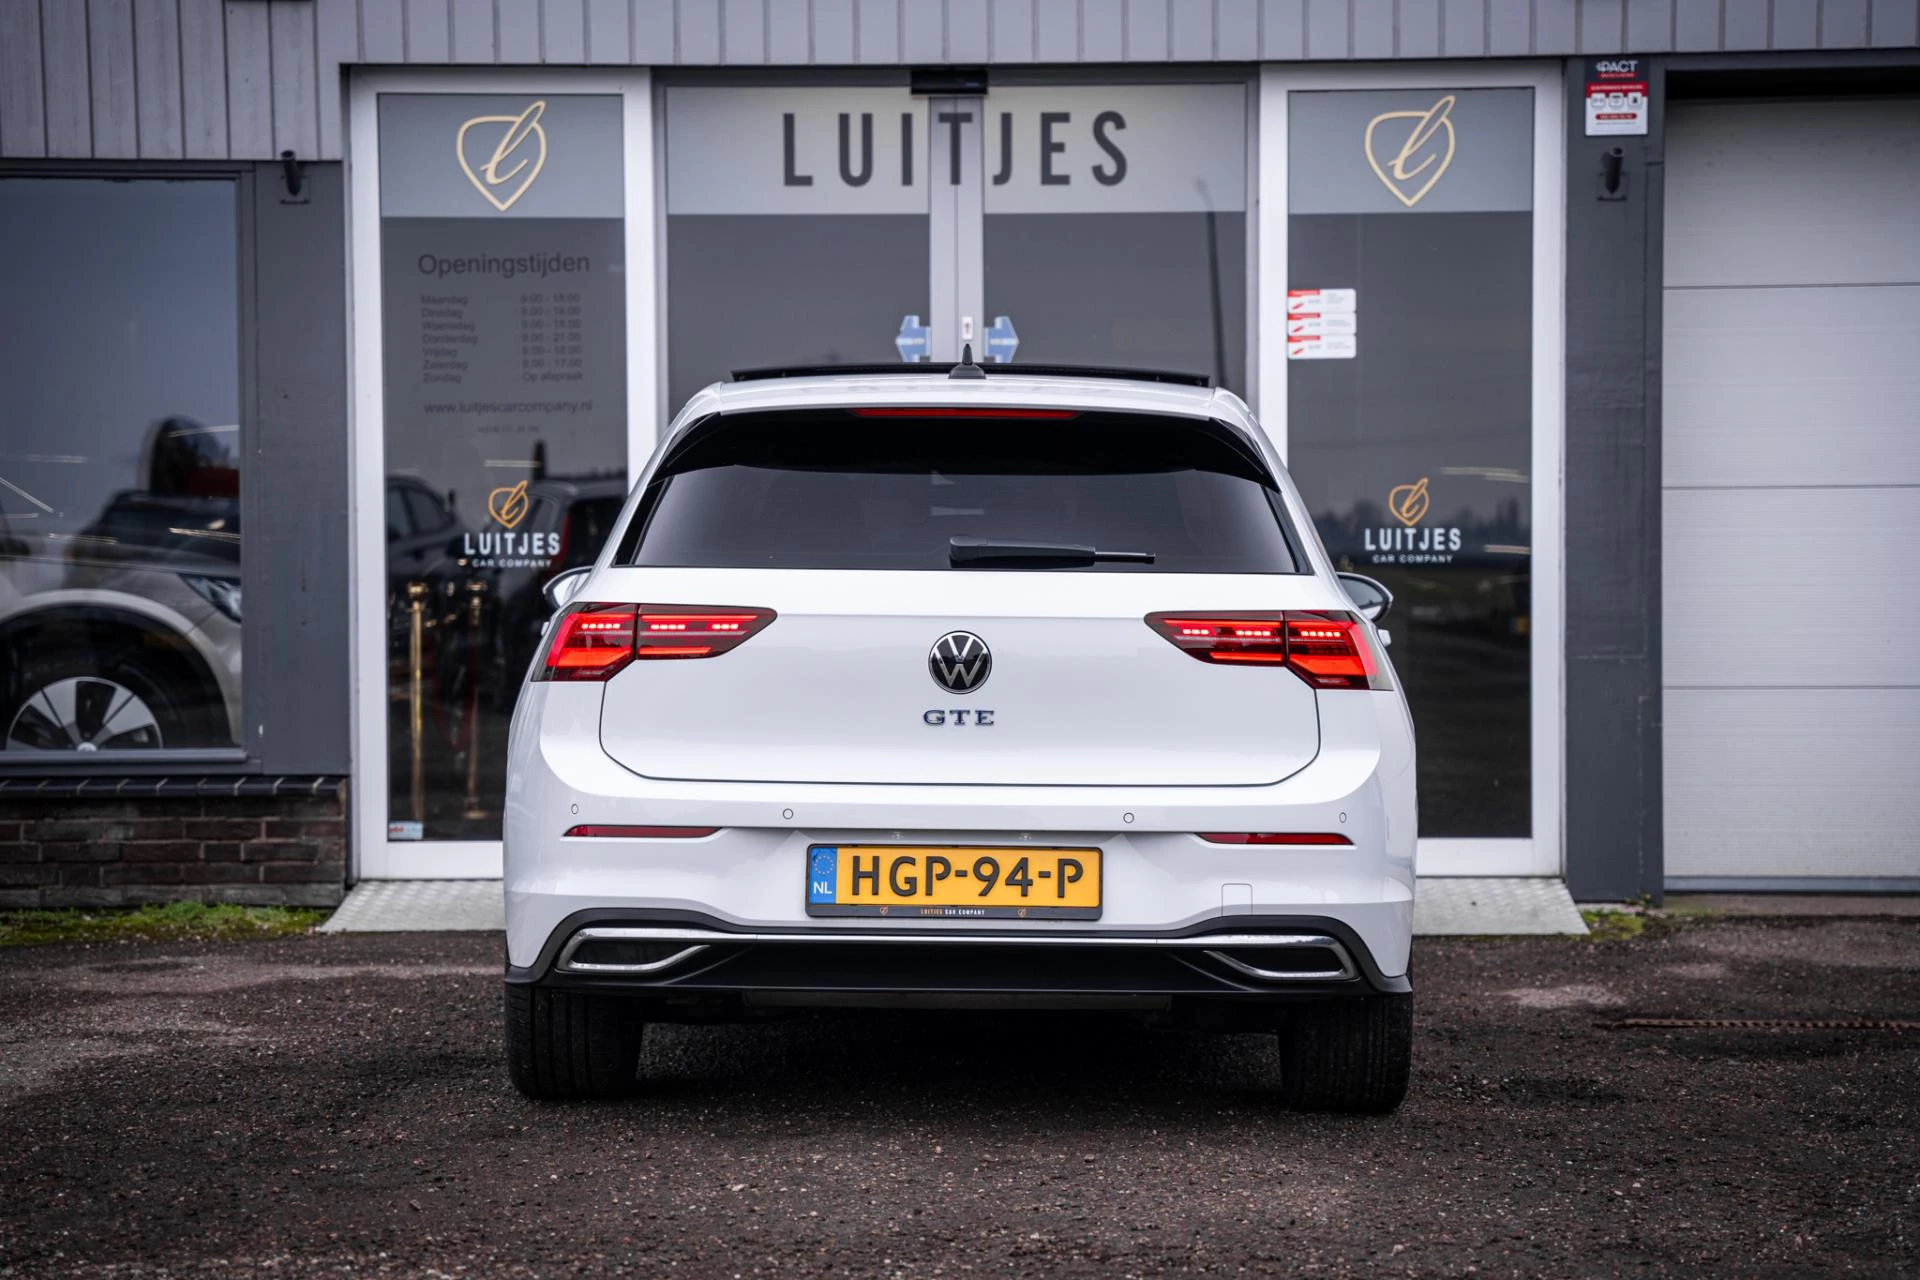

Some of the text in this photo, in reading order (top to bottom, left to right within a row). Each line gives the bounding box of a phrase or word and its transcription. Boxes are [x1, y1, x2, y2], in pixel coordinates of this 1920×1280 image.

[783, 110, 1127, 187] LUITJES
[418, 253, 591, 279] Openingstijden
[424, 401, 593, 415] www.luitjescarcompany.nl
[464, 532, 560, 555] LUITJES
[1364, 527, 1461, 551] LUITJES
[472, 559, 552, 568] CAR COMPANY
[1372, 554, 1453, 563] CAR COMPANY
[923, 709, 994, 726] GTE
[852, 855, 1084, 898] HGP-94-P
[813, 881, 832, 894] NL
[958, 908, 985, 916] COMPANY
